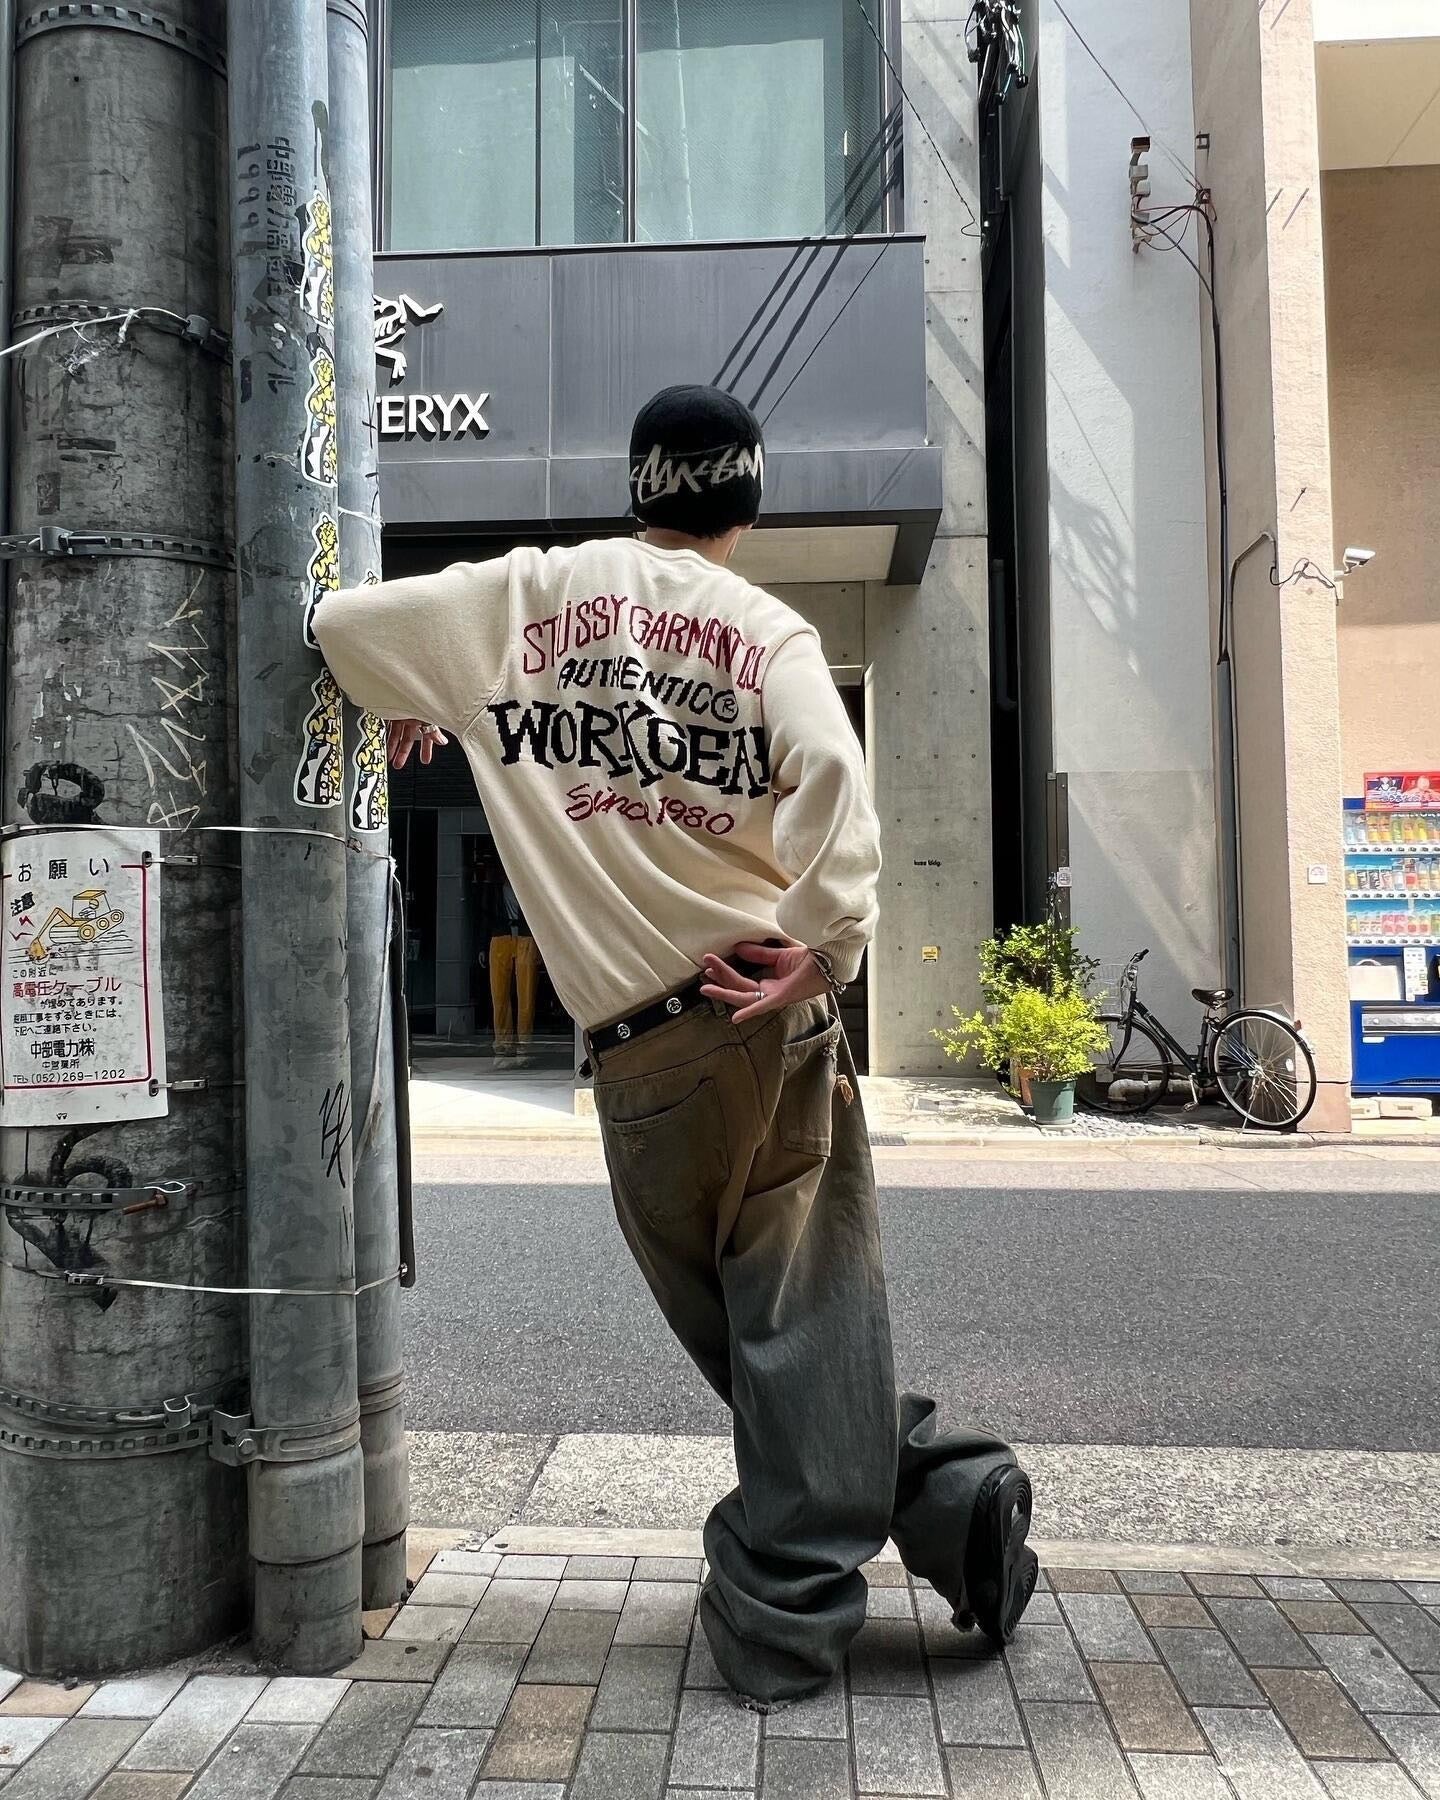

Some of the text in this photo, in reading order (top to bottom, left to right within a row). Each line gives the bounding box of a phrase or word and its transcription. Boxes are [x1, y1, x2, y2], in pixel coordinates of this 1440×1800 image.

[237, 142, 261, 230] 1999
[629, 605, 745, 673] GARMENT
[656, 796, 735, 835] 1980
[18, 858, 109, 882] お願い
[12, 976, 122, 998] 高電圧ケーブル
